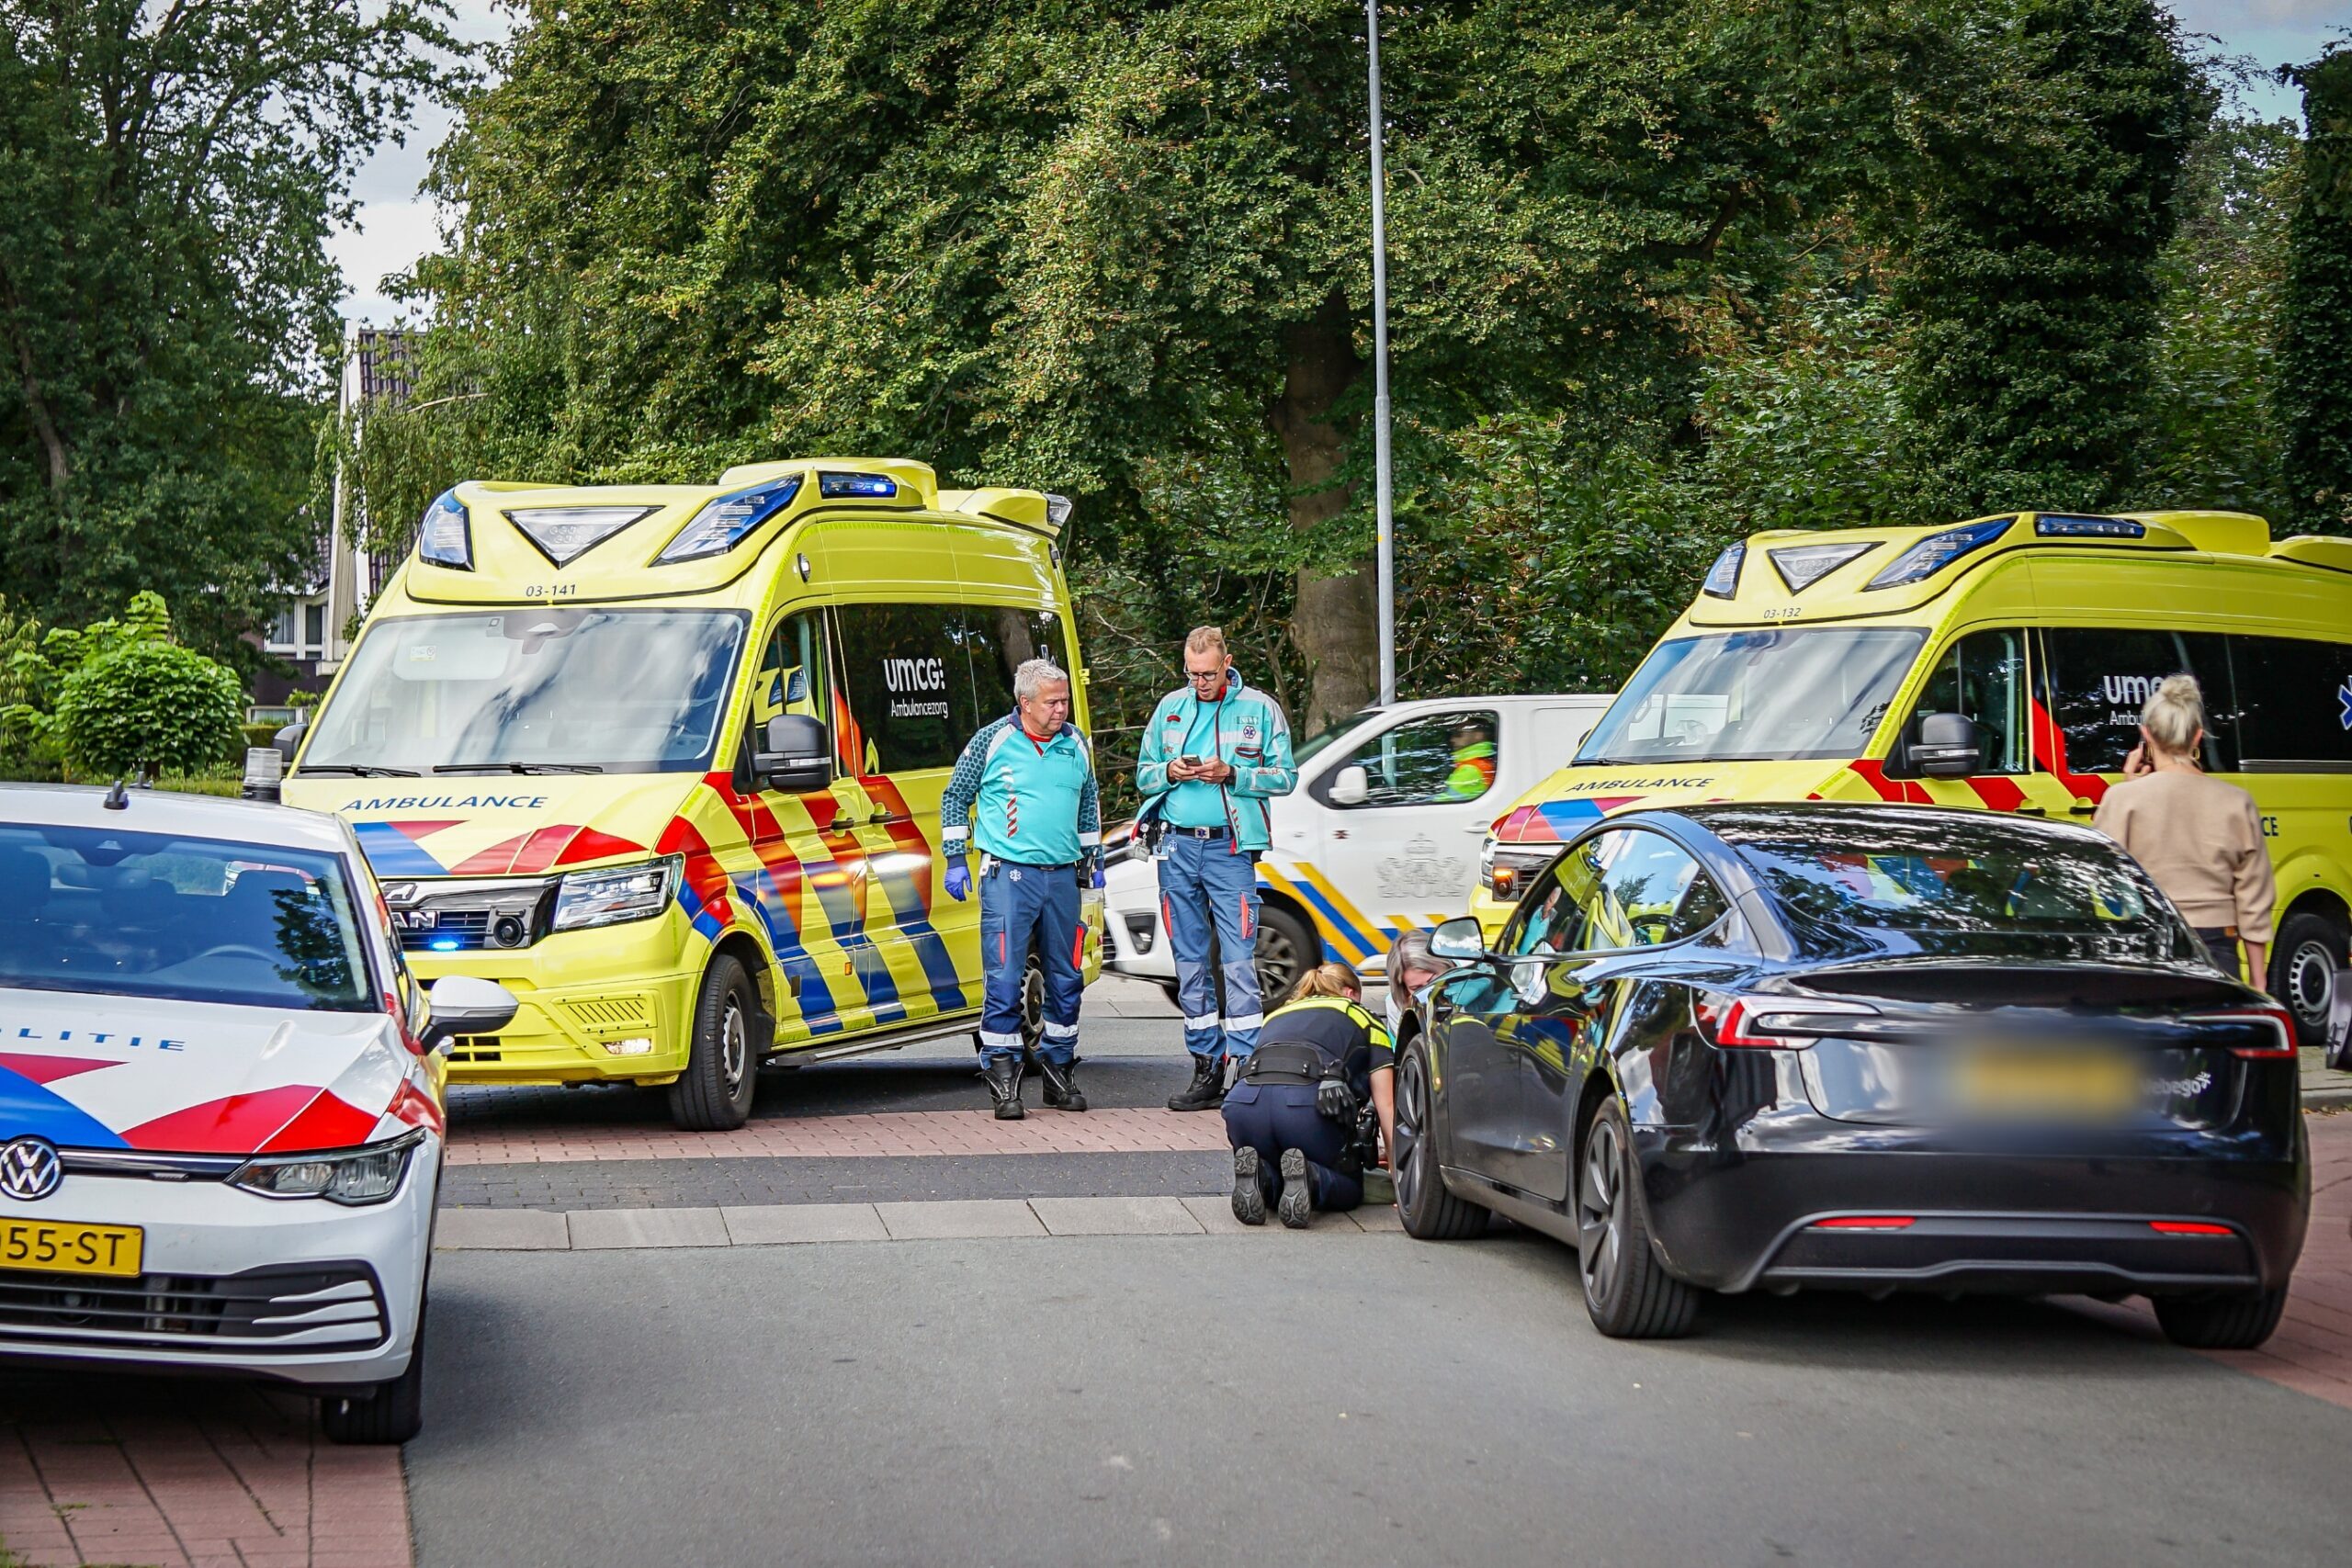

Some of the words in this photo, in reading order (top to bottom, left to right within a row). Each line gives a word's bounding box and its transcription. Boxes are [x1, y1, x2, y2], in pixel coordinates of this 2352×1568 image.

[526, 583, 576, 597] 03-141
[1763, 607, 1802, 619] 03-132
[891, 697, 949, 719] Ambulancezorg
[1565, 778, 1715, 793] AMBULANCE
[340, 795, 548, 812] AMBULANCE
[390, 911, 435, 929] AN
[0, 1027, 187, 1052] LITIE
[0, 1226, 126, 1266] 55-ST
